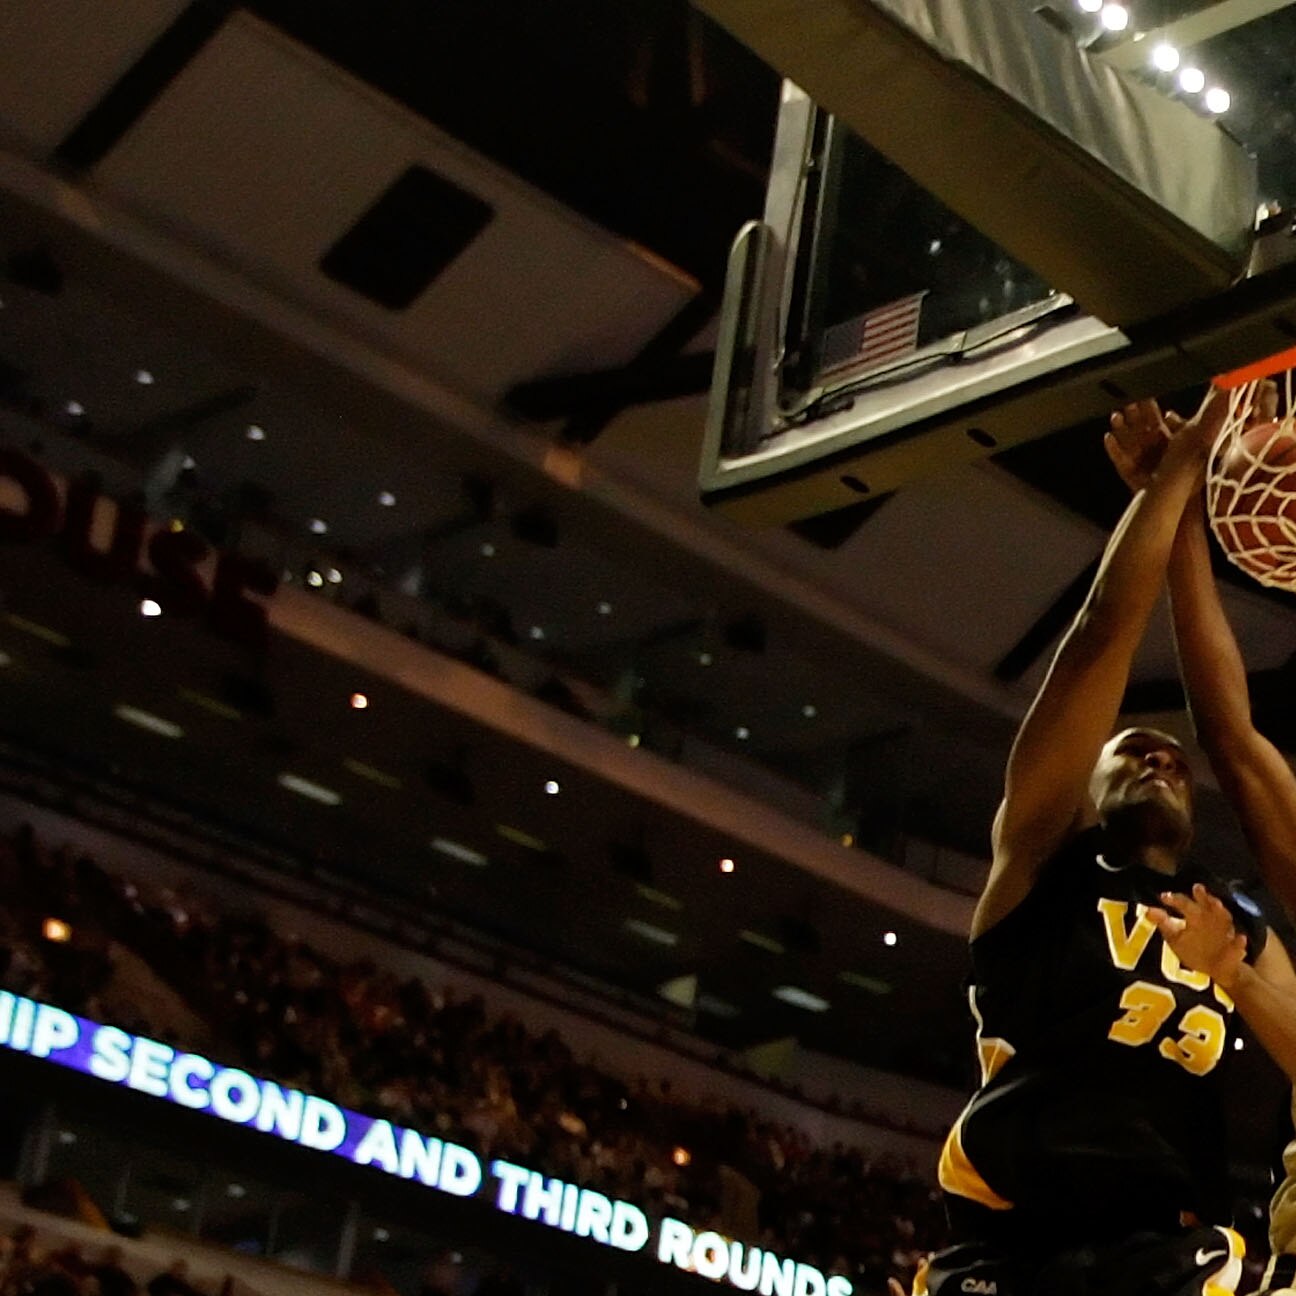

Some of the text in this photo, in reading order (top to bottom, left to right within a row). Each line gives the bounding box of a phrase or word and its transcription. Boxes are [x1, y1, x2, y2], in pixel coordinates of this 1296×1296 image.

[1107, 980, 1226, 1077] 33
[90, 1026, 346, 1150] SECOND
[353, 1119, 482, 1196] AND
[493, 1159, 649, 1252] THIRD
